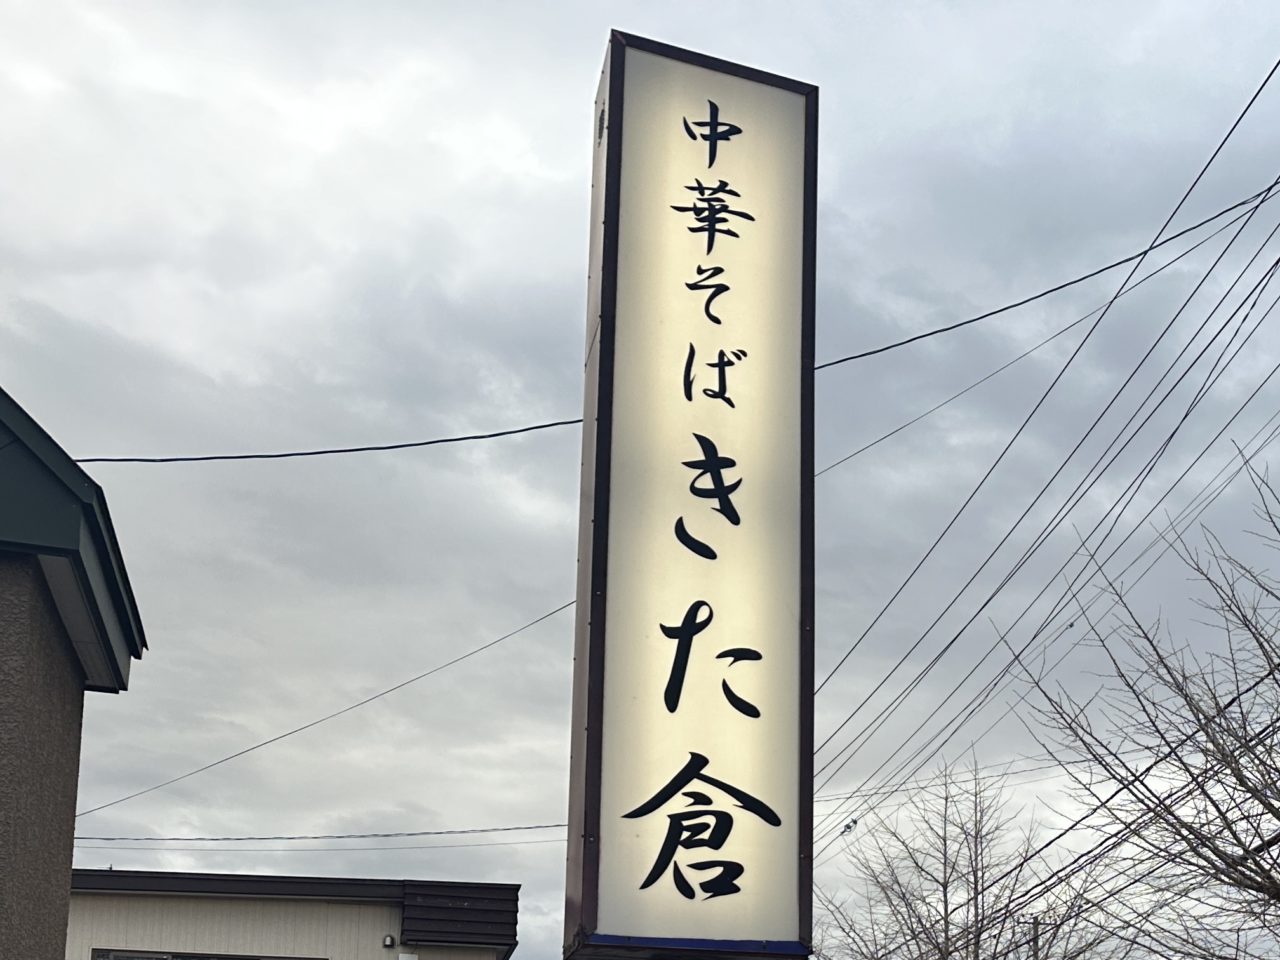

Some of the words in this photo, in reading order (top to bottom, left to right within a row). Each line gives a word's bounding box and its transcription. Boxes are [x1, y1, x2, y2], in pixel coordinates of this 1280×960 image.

[620, 99, 782, 900] 中華そばきた倉
